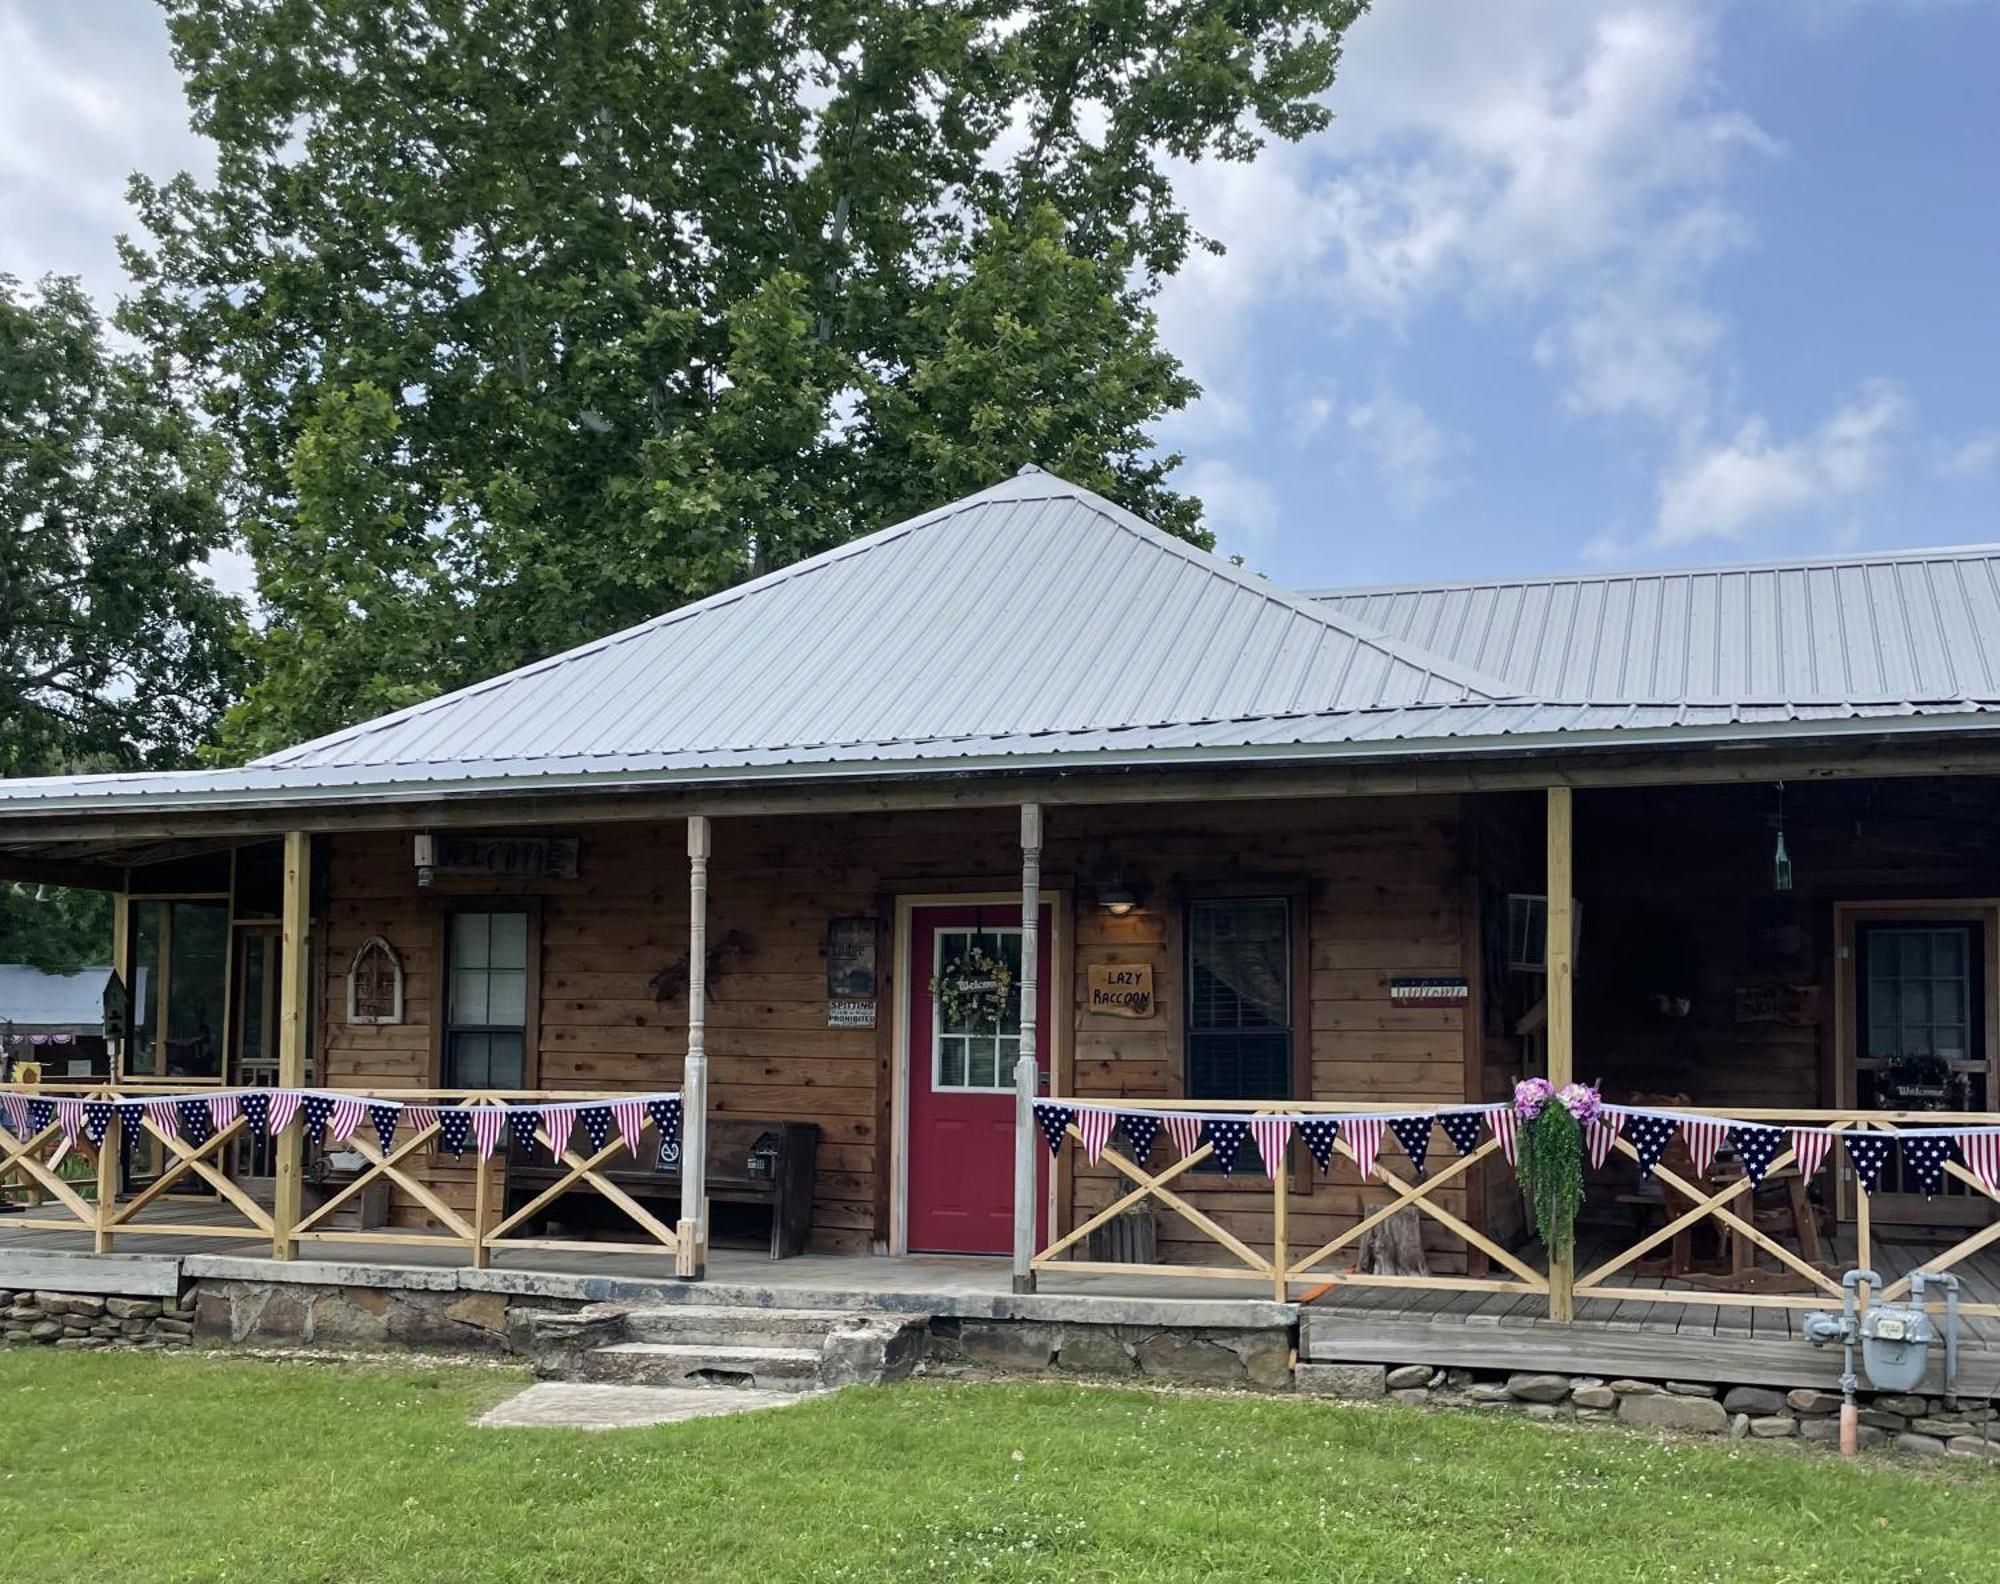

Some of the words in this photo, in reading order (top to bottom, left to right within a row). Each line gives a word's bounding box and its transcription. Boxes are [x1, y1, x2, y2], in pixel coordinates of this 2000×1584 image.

[1108, 972, 1142, 985] LAZY
[957, 979, 997, 991] Welcom
[1094, 988, 1150, 1005] RACCOON
[831, 1000, 874, 1009] SPITTING
